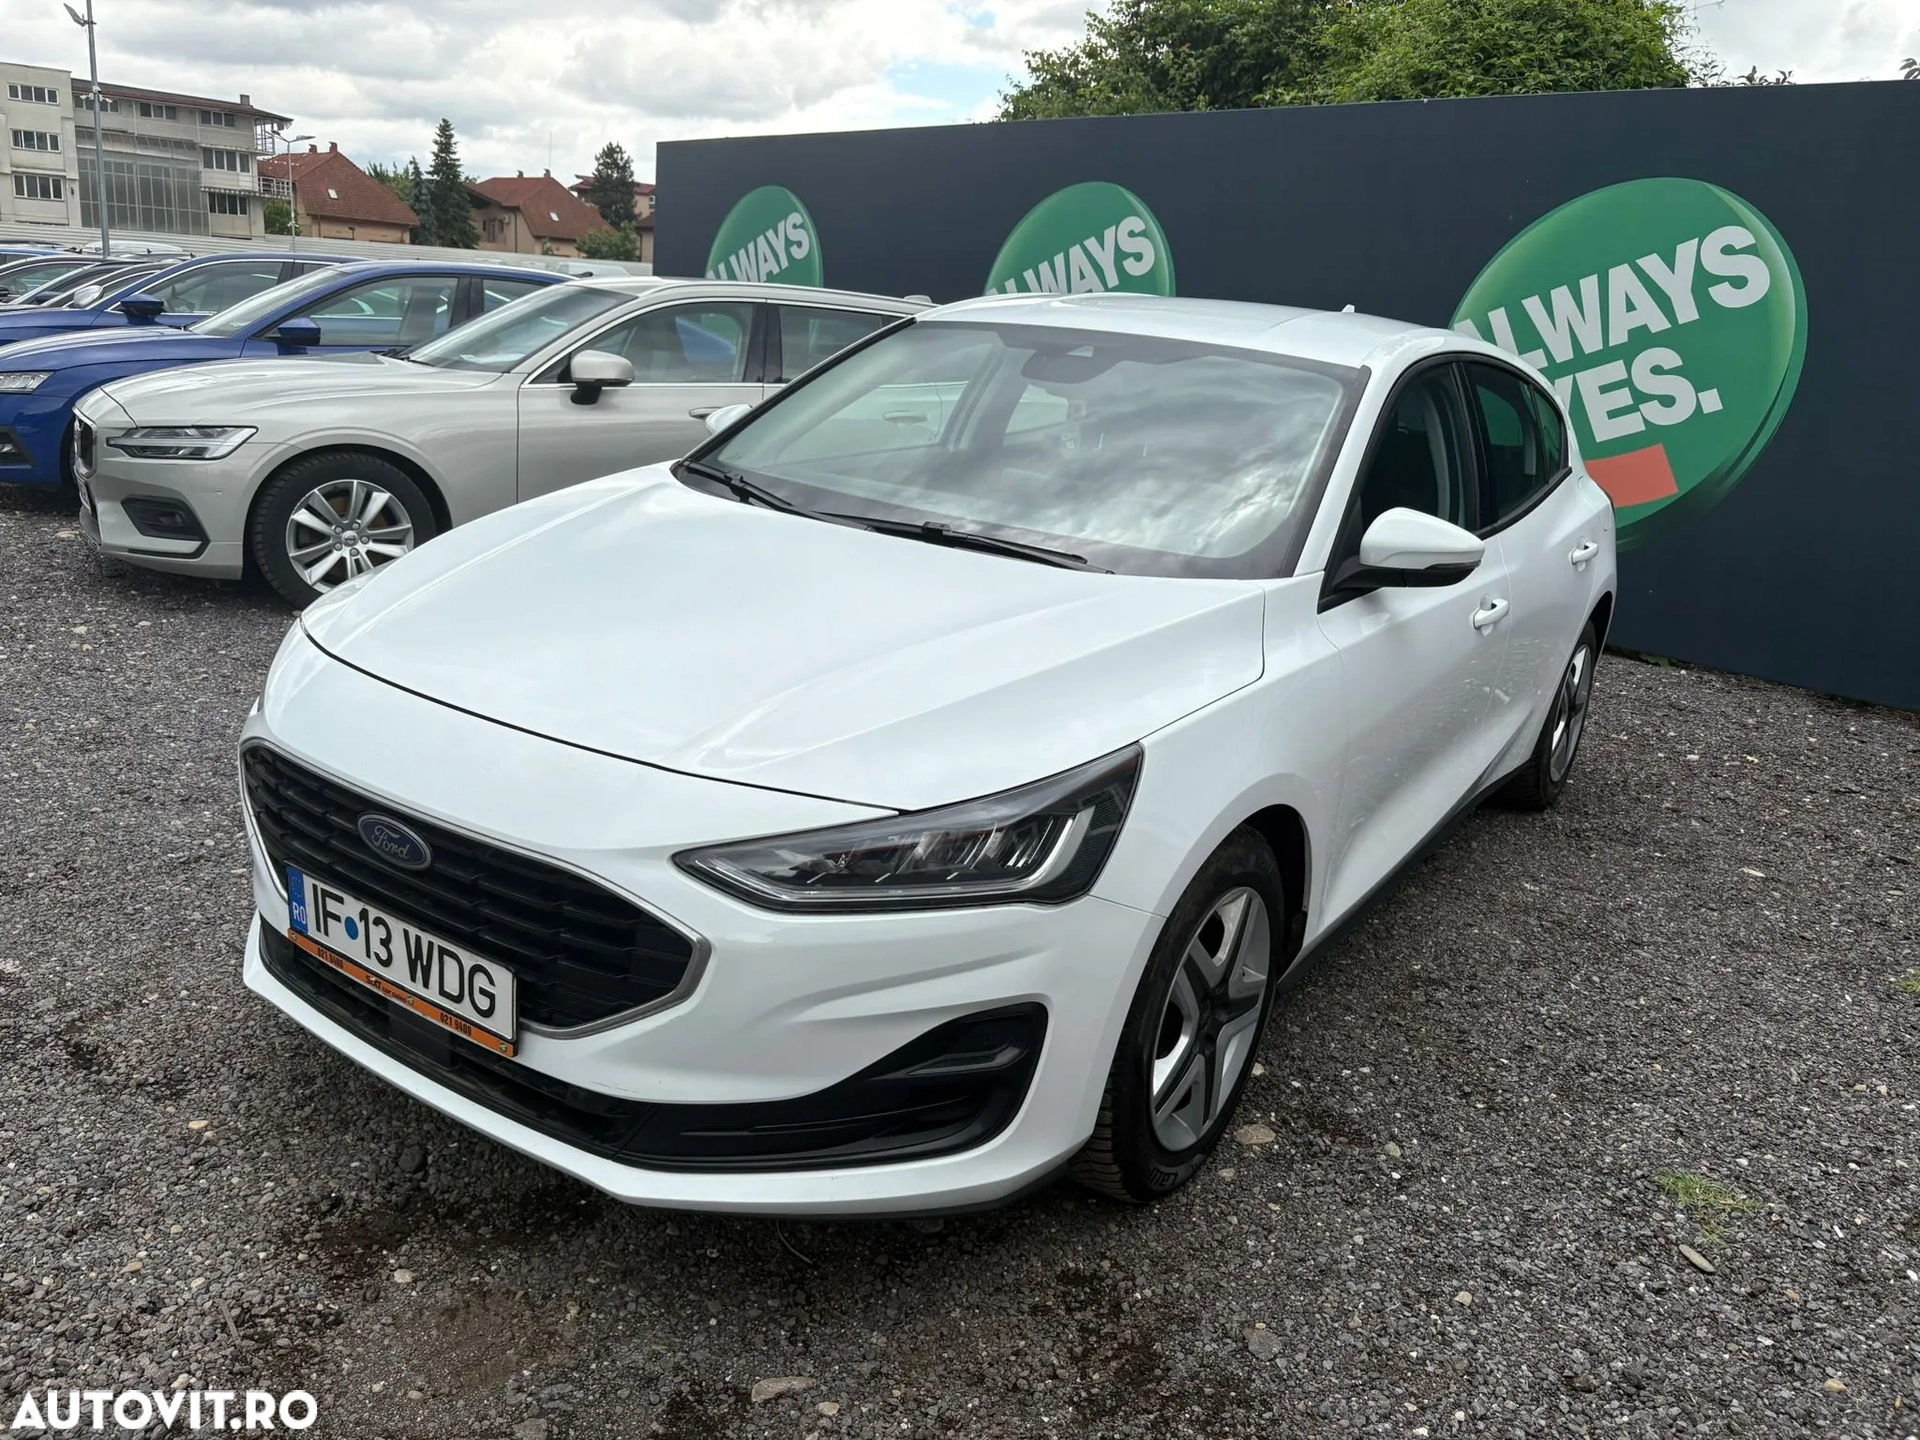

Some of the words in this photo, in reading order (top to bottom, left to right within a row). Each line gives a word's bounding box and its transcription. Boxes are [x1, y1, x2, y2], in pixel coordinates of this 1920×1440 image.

[706, 212, 810, 282] WAYS
[986, 215, 1155, 295] WAYS
[1454, 225, 1771, 371] LWAYS
[371, 825, 410, 859] Ford
[292, 901, 306, 925] RO
[312, 883, 344, 937] IF
[359, 907, 393, 968] 13
[403, 927, 496, 1018] WDG
[440, 1011, 452, 1027] 021
